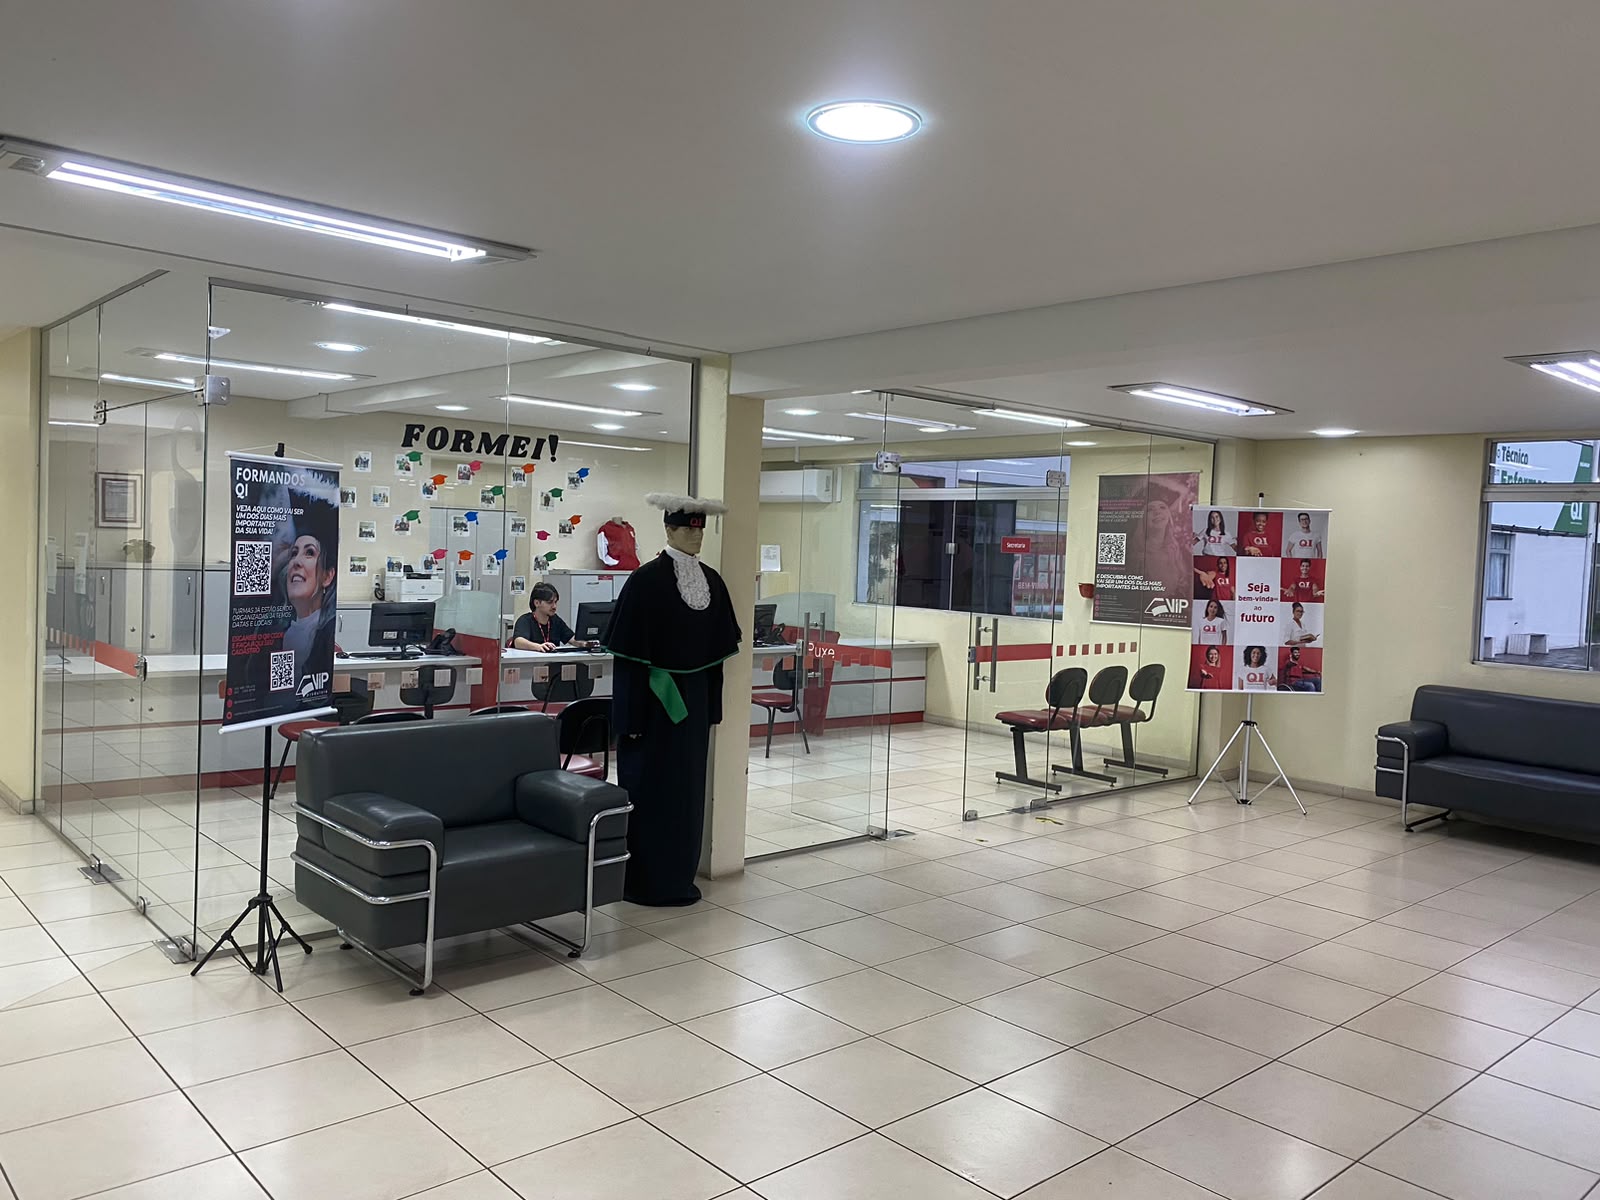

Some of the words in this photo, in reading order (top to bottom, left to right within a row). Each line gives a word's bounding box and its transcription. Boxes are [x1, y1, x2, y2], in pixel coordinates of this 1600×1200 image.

[401, 424, 559, 462] FORMEI!
[1502, 446, 1528, 464] Técnico
[236, 468, 305, 486] FORMANDOS
[236, 483, 248, 499] QI
[1570, 502, 1583, 520] QI
[1208, 536, 1222, 544] QI
[1254, 536, 1268, 546] QI
[1299, 540, 1312, 548] QI
[1217, 578, 1230, 586] QI
[1248, 582, 1270, 593] Seja
[1165, 598, 1189, 613] VIP
[1240, 613, 1275, 623] futuro
[808, 642, 835, 658] Puxe
[312, 672, 329, 690] VIP
[1246, 673, 1265, 683] QI
